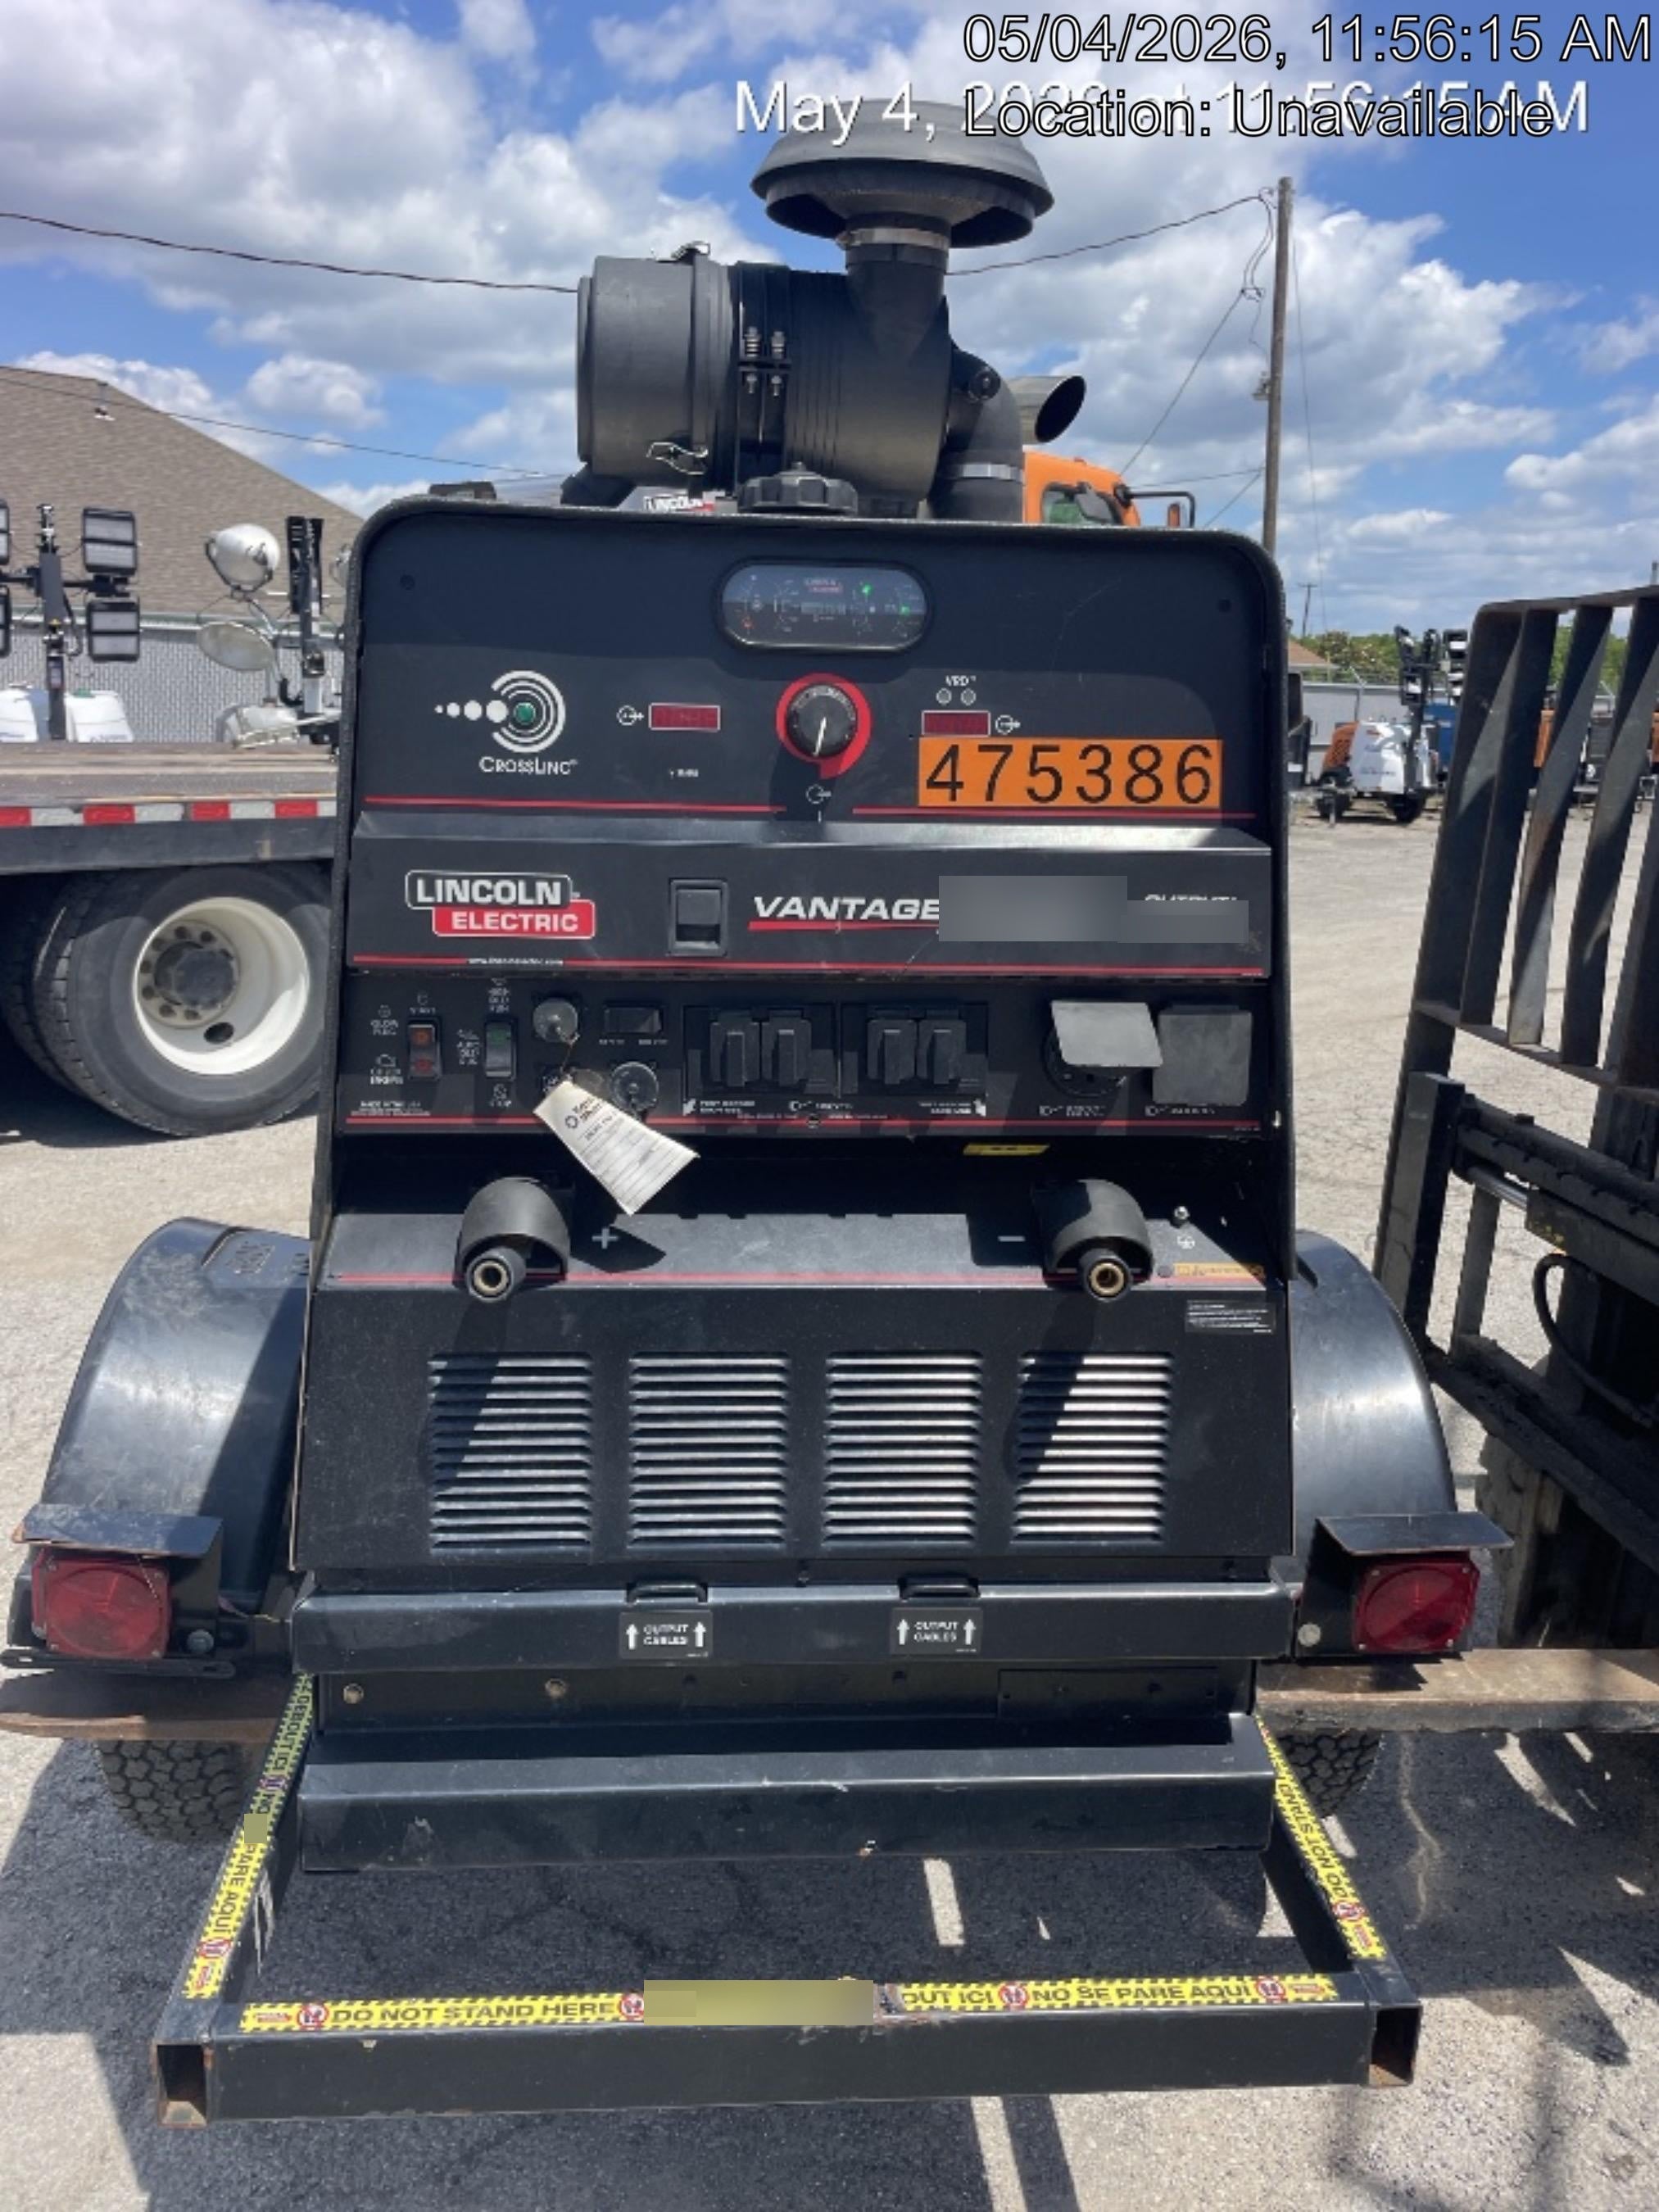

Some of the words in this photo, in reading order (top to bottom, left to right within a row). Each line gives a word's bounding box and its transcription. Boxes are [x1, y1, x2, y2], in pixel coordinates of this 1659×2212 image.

[926, 744, 1213, 805] 475386
[416, 878, 562, 906] LINCOLN
[752, 896, 939, 921] VANTAGE
[452, 911, 579, 932] ELECTRIC
[1031, 1988, 1070, 2001] NO
[333, 2009, 374, 2023] DO
[380, 2006, 437, 2021] NOT
[443, 2004, 533, 2019] STAND
[542, 2001, 614, 2016] HERE
